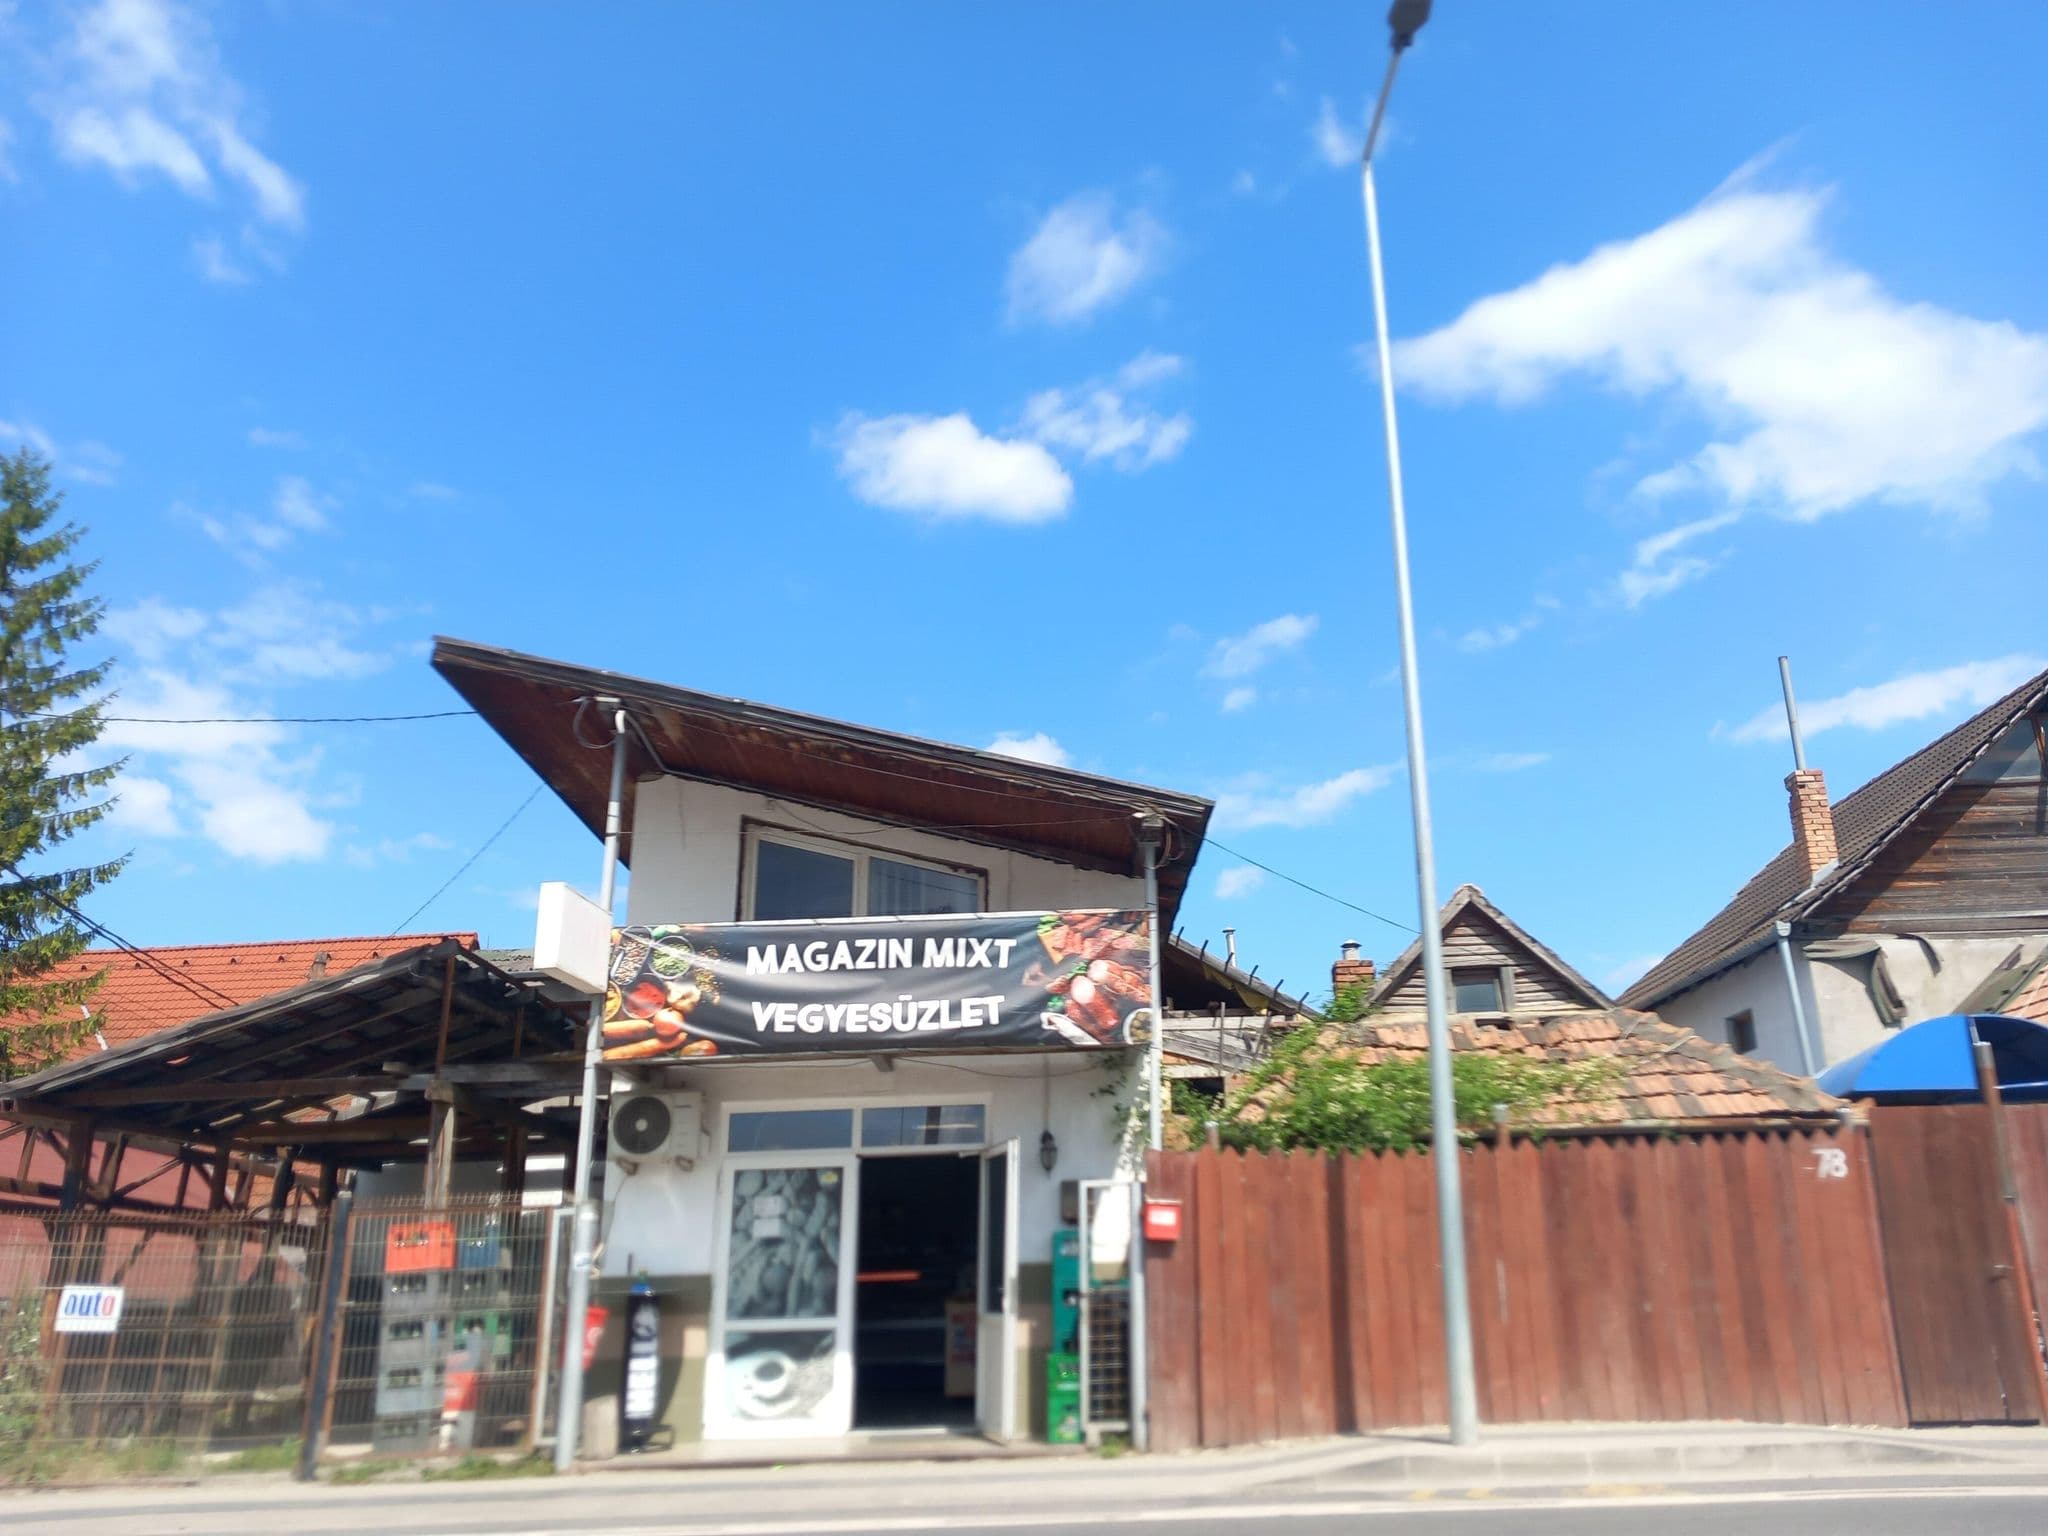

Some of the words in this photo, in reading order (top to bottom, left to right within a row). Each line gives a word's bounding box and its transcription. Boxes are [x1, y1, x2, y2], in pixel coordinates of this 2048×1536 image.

[746, 938, 913, 976] MAGAZIN
[923, 938, 1017, 968] MIXT
[751, 995, 1005, 1033] VEGYESÜZLET
[1811, 1148, 1849, 1178] 78
